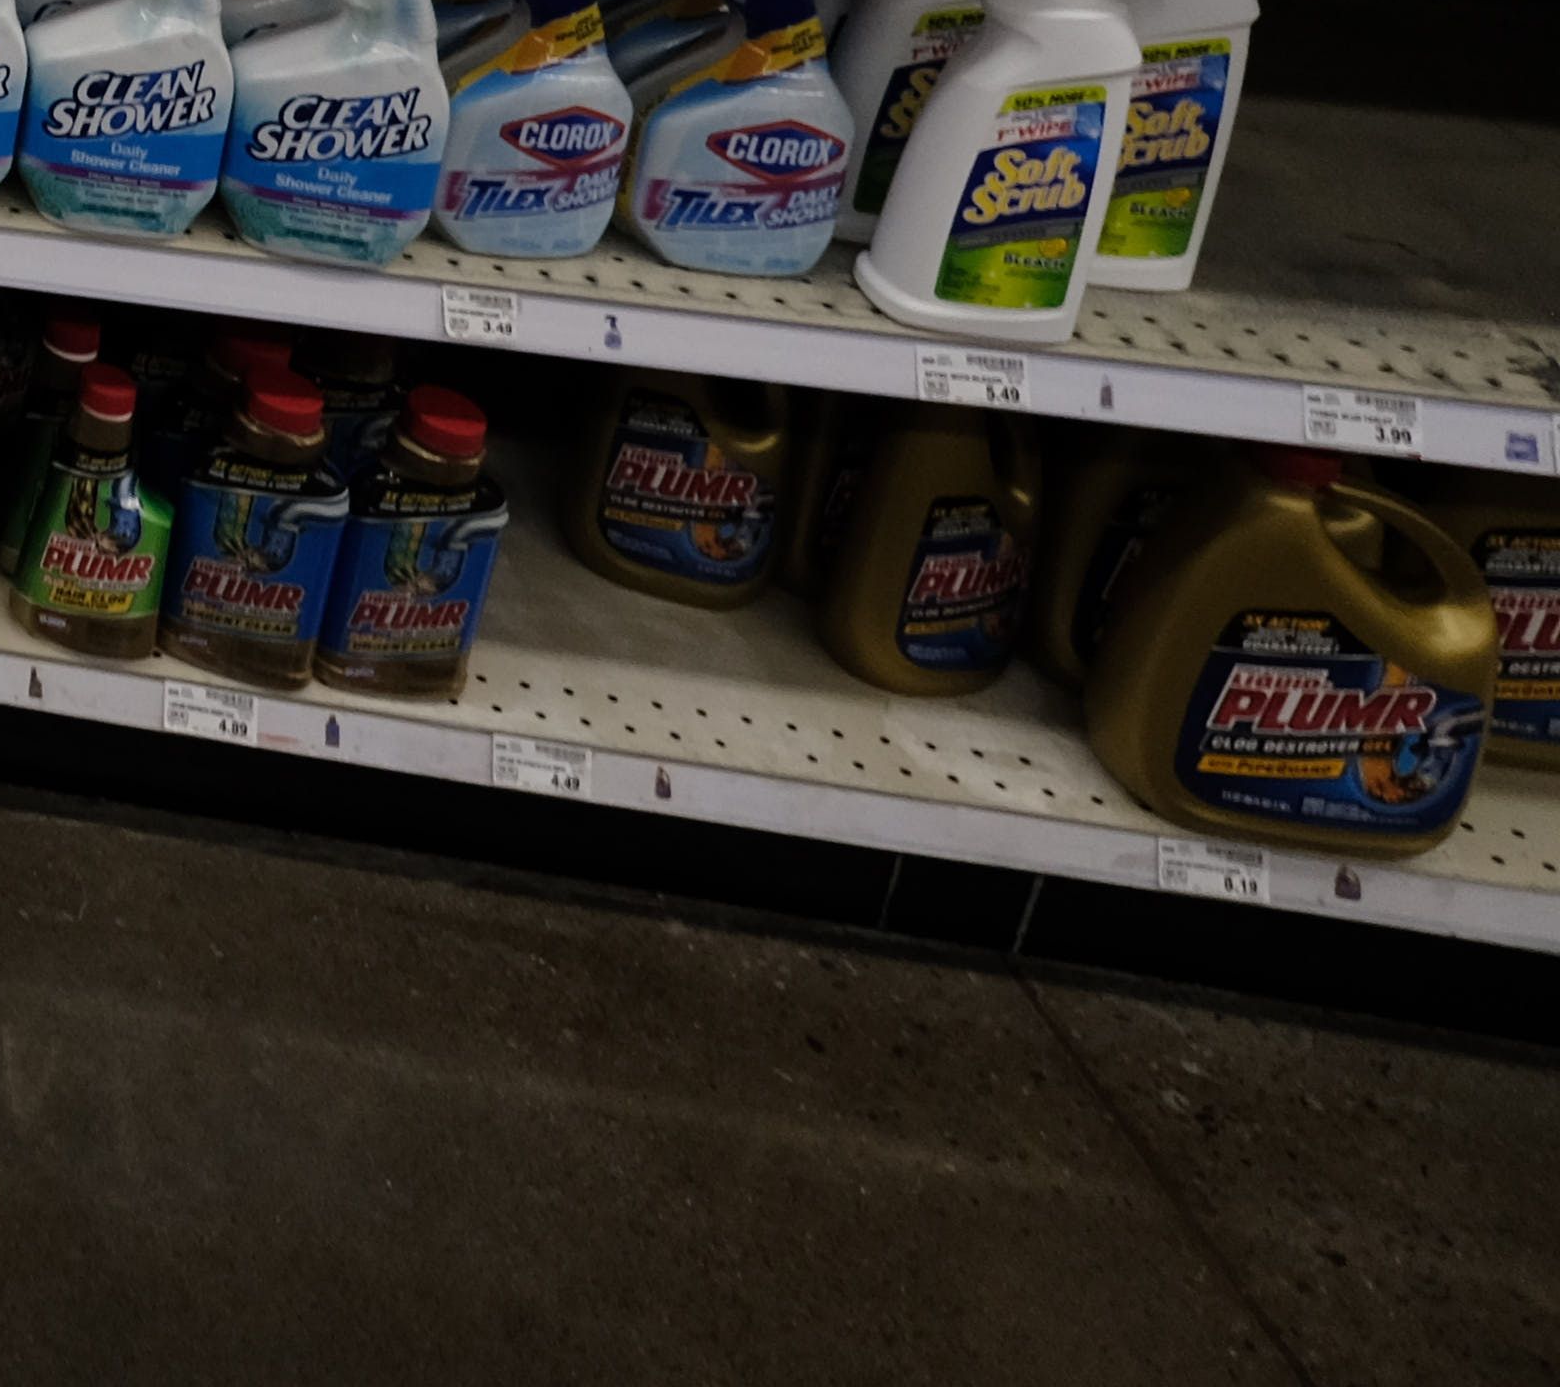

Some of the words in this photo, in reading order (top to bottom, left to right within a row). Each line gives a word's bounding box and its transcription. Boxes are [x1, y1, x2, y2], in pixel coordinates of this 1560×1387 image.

[43, 86, 217, 138] SHOWER
[40, 547, 154, 586] PLUMR
[1206, 687, 1436, 733] PLUMR
